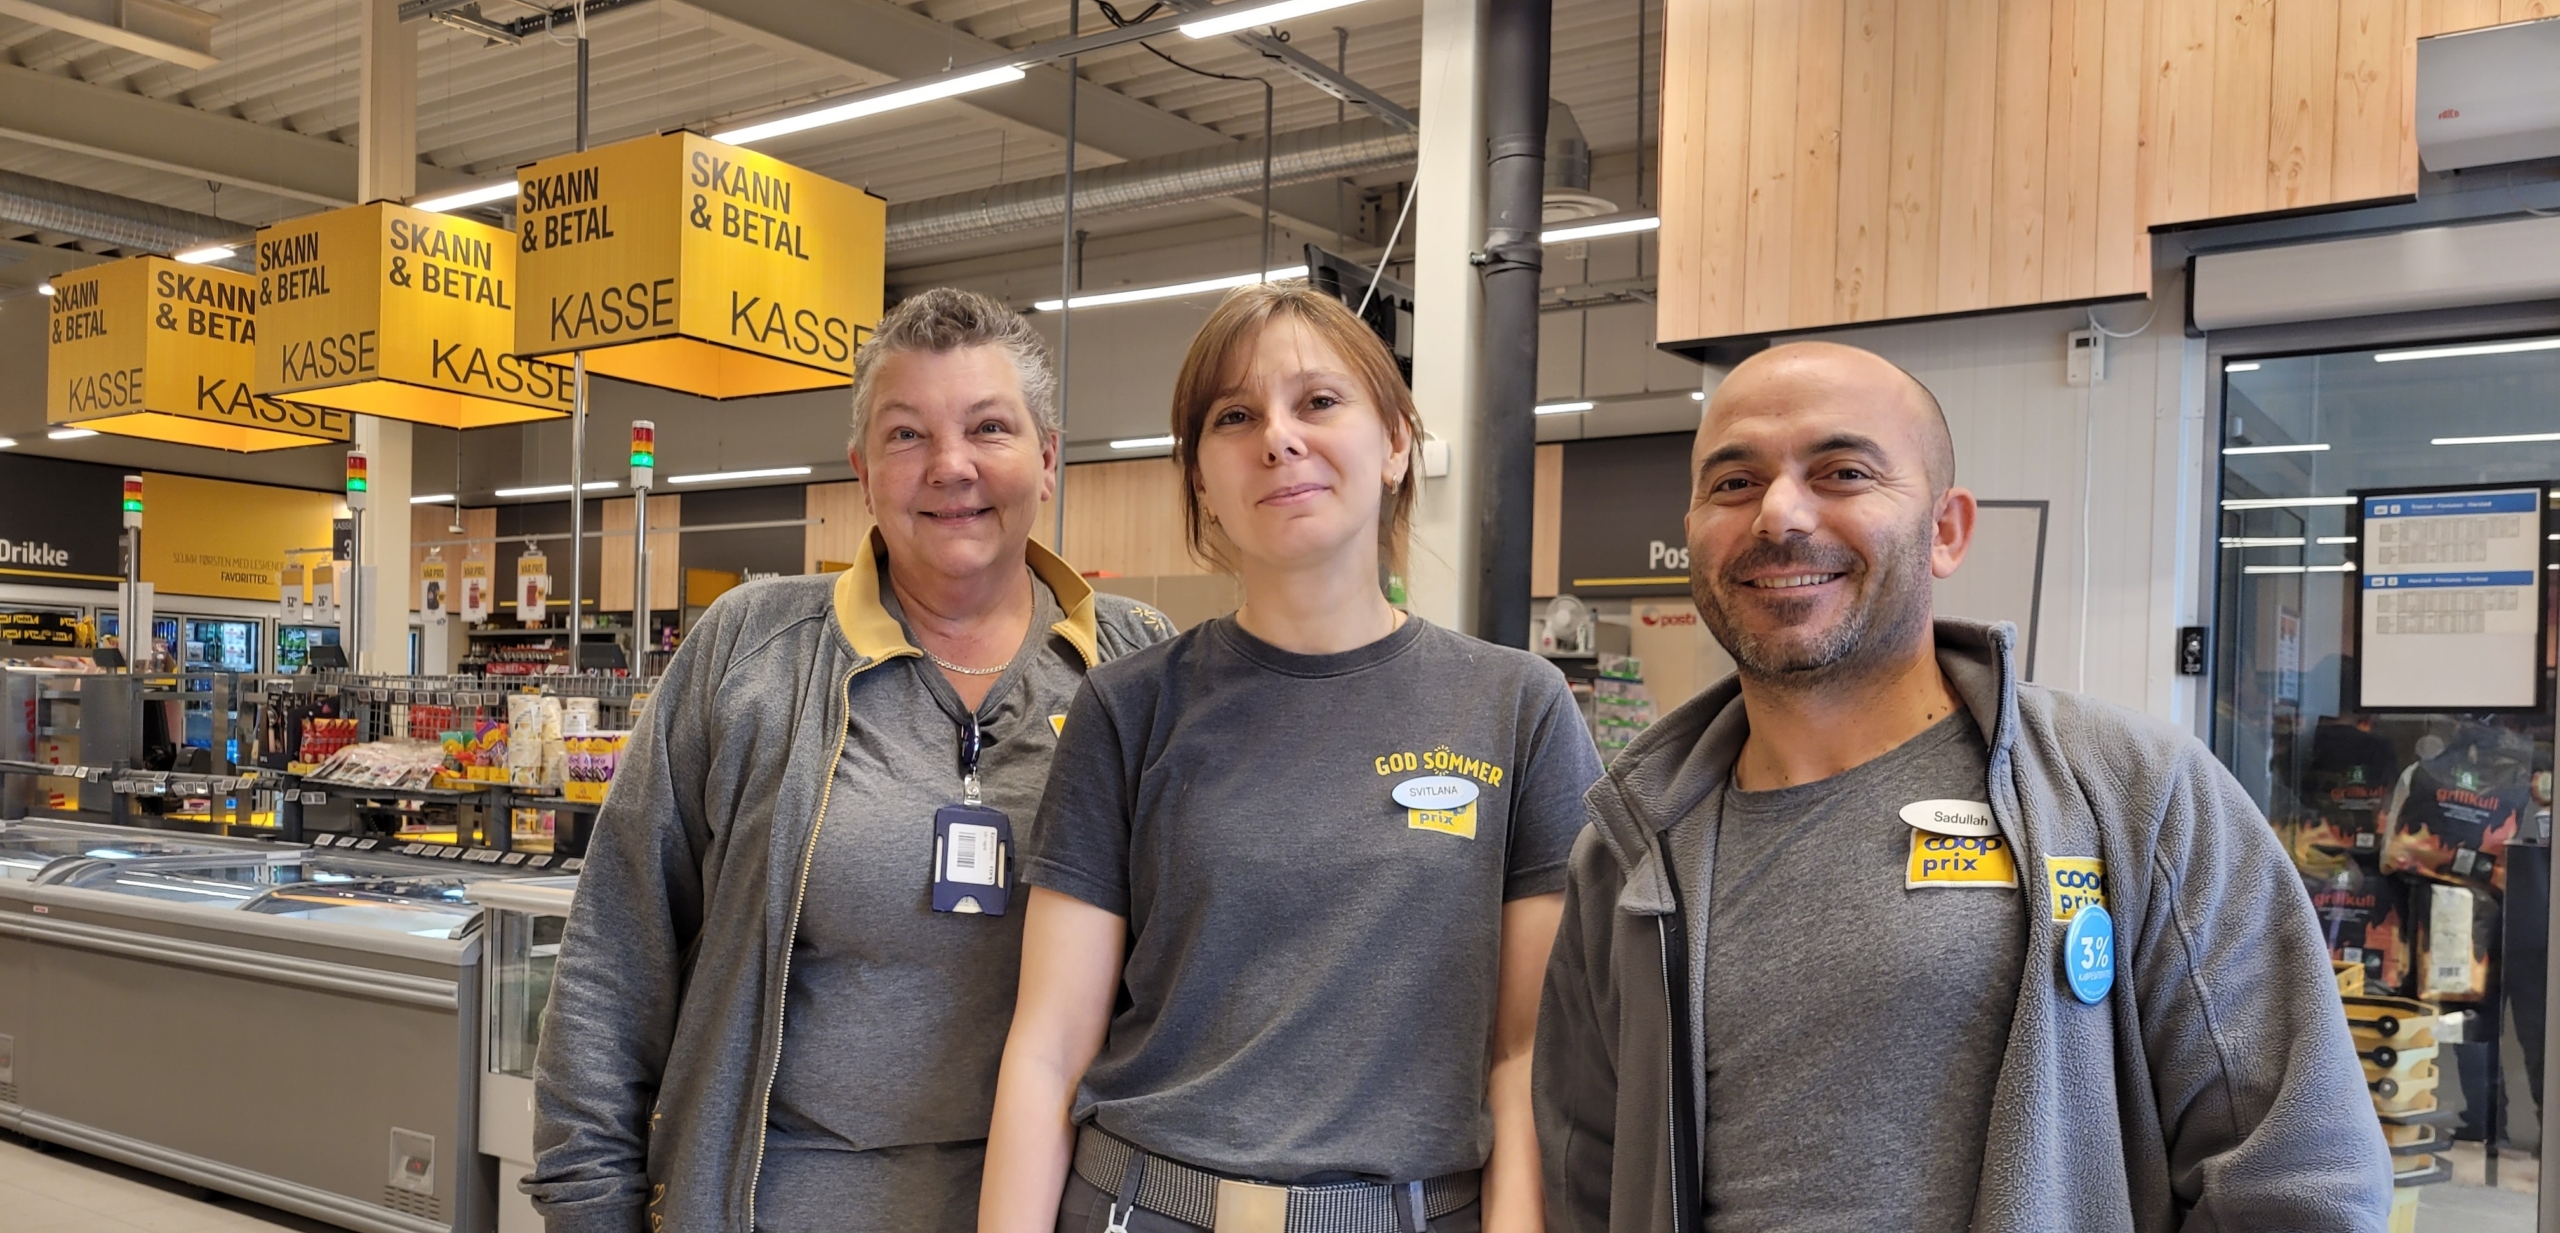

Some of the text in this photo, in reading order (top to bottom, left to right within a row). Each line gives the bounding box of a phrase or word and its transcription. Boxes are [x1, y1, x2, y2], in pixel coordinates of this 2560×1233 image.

[522, 166, 599, 215] SKANN
[692, 151, 792, 215] SKANN
[389, 219, 492, 272] SKANN
[521, 204, 614, 253] & BETAL
[690, 194, 810, 261] & BETAL
[260, 231, 319, 272] SKANN
[53, 279, 99, 315] SKANN
[155, 270, 256, 316] SKANN
[259, 265, 331, 306] & BETAL
[389, 256, 512, 311] & BETAL
[52, 309, 108, 344] & BETAL
[155, 303, 256, 346] & BETA
[551, 278, 675, 342] KASSE
[281, 330, 376, 384] KASSE
[431, 339, 574, 404] KASSE
[69, 367, 143, 413] KASSE
[197, 375, 343, 433] KASSE
[0, 538, 69, 567] Drikke
[343, 539, 352, 560] 3
[1649, 541, 1690, 570] Pos
[1375, 750, 1504, 788] GOD SOMMER
[1409, 786, 1458, 797] SVITLANA
[2436, 787, 2499, 810] grillkull
[1420, 811, 1454, 826] prix
[1934, 811, 1988, 827] Sadullah
[1923, 853, 1978, 877] prix
[1924, 836, 2002, 855] coop
[2081, 935, 2110, 970] 3%
